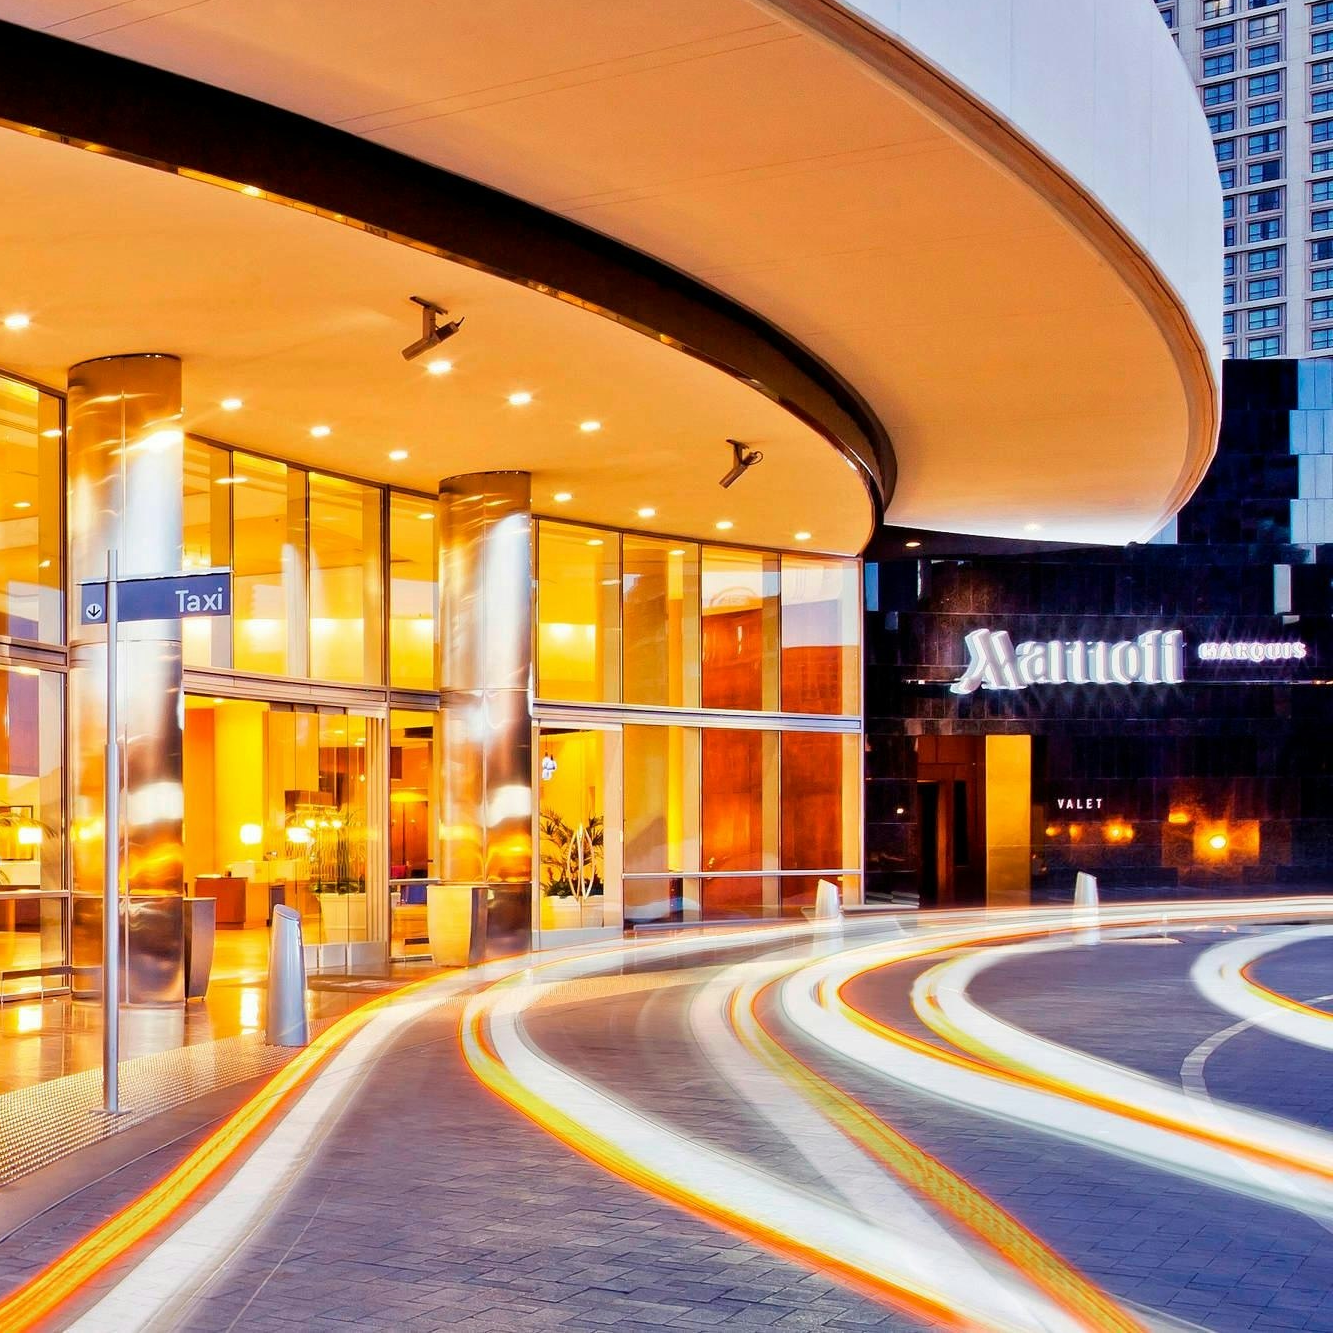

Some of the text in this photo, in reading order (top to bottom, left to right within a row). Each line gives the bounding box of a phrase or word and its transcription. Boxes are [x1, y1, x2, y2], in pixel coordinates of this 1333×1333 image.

[174, 586, 223, 613] Taxi
[949, 628, 1307, 694] Marriott MARQUIS
[1057, 798, 1103, 810] VALET
